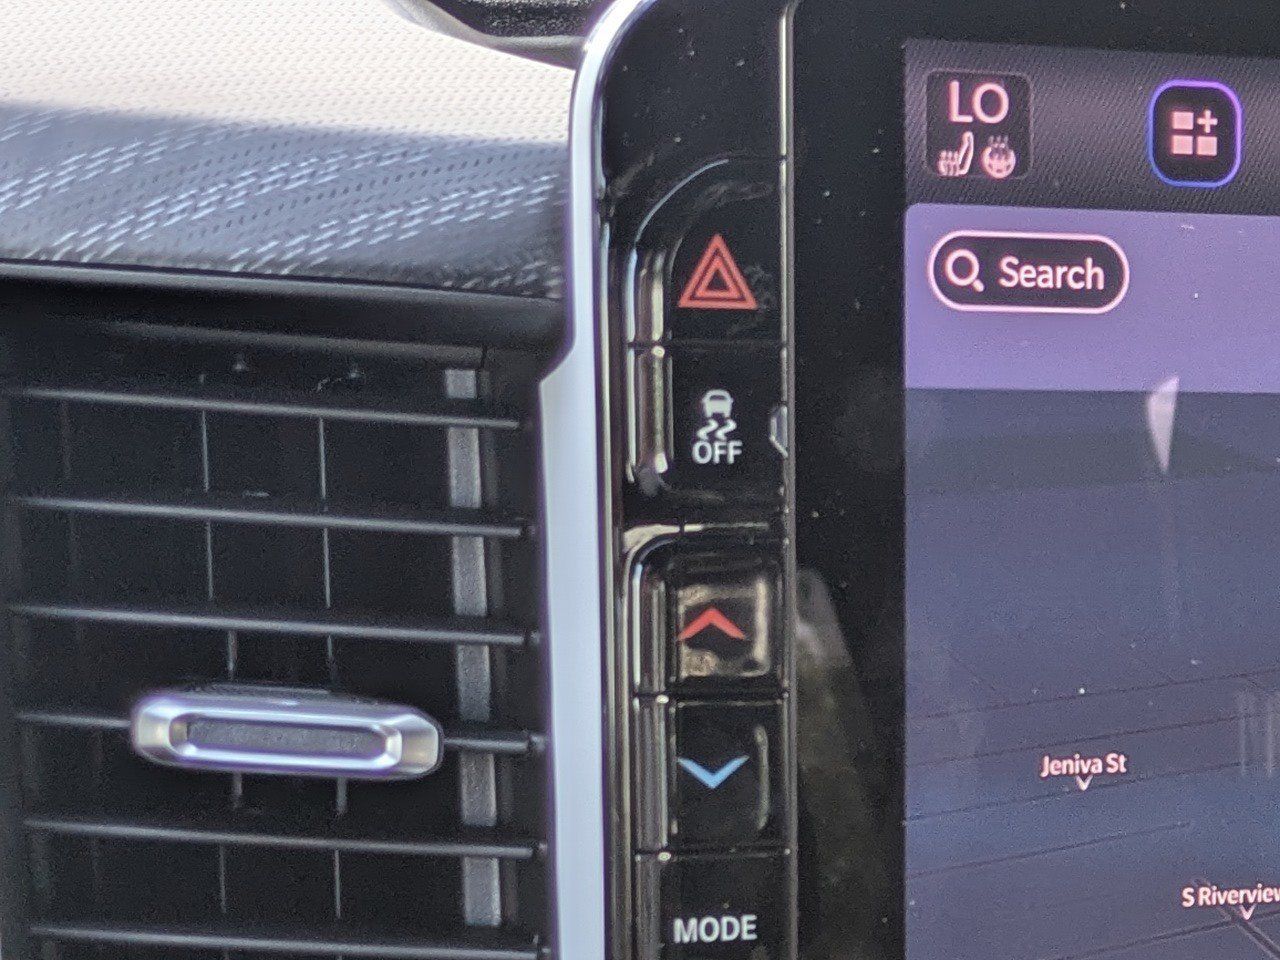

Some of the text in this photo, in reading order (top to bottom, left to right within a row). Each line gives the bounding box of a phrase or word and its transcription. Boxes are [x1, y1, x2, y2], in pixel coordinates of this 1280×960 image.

[947, 79, 1010, 124] LO
[999, 256, 1105, 291] Search
[691, 440, 743, 464] OFF
[1040, 752, 1127, 778] Jeniva St
[1181, 886, 1195, 908] S
[673, 915, 758, 944] MODE
